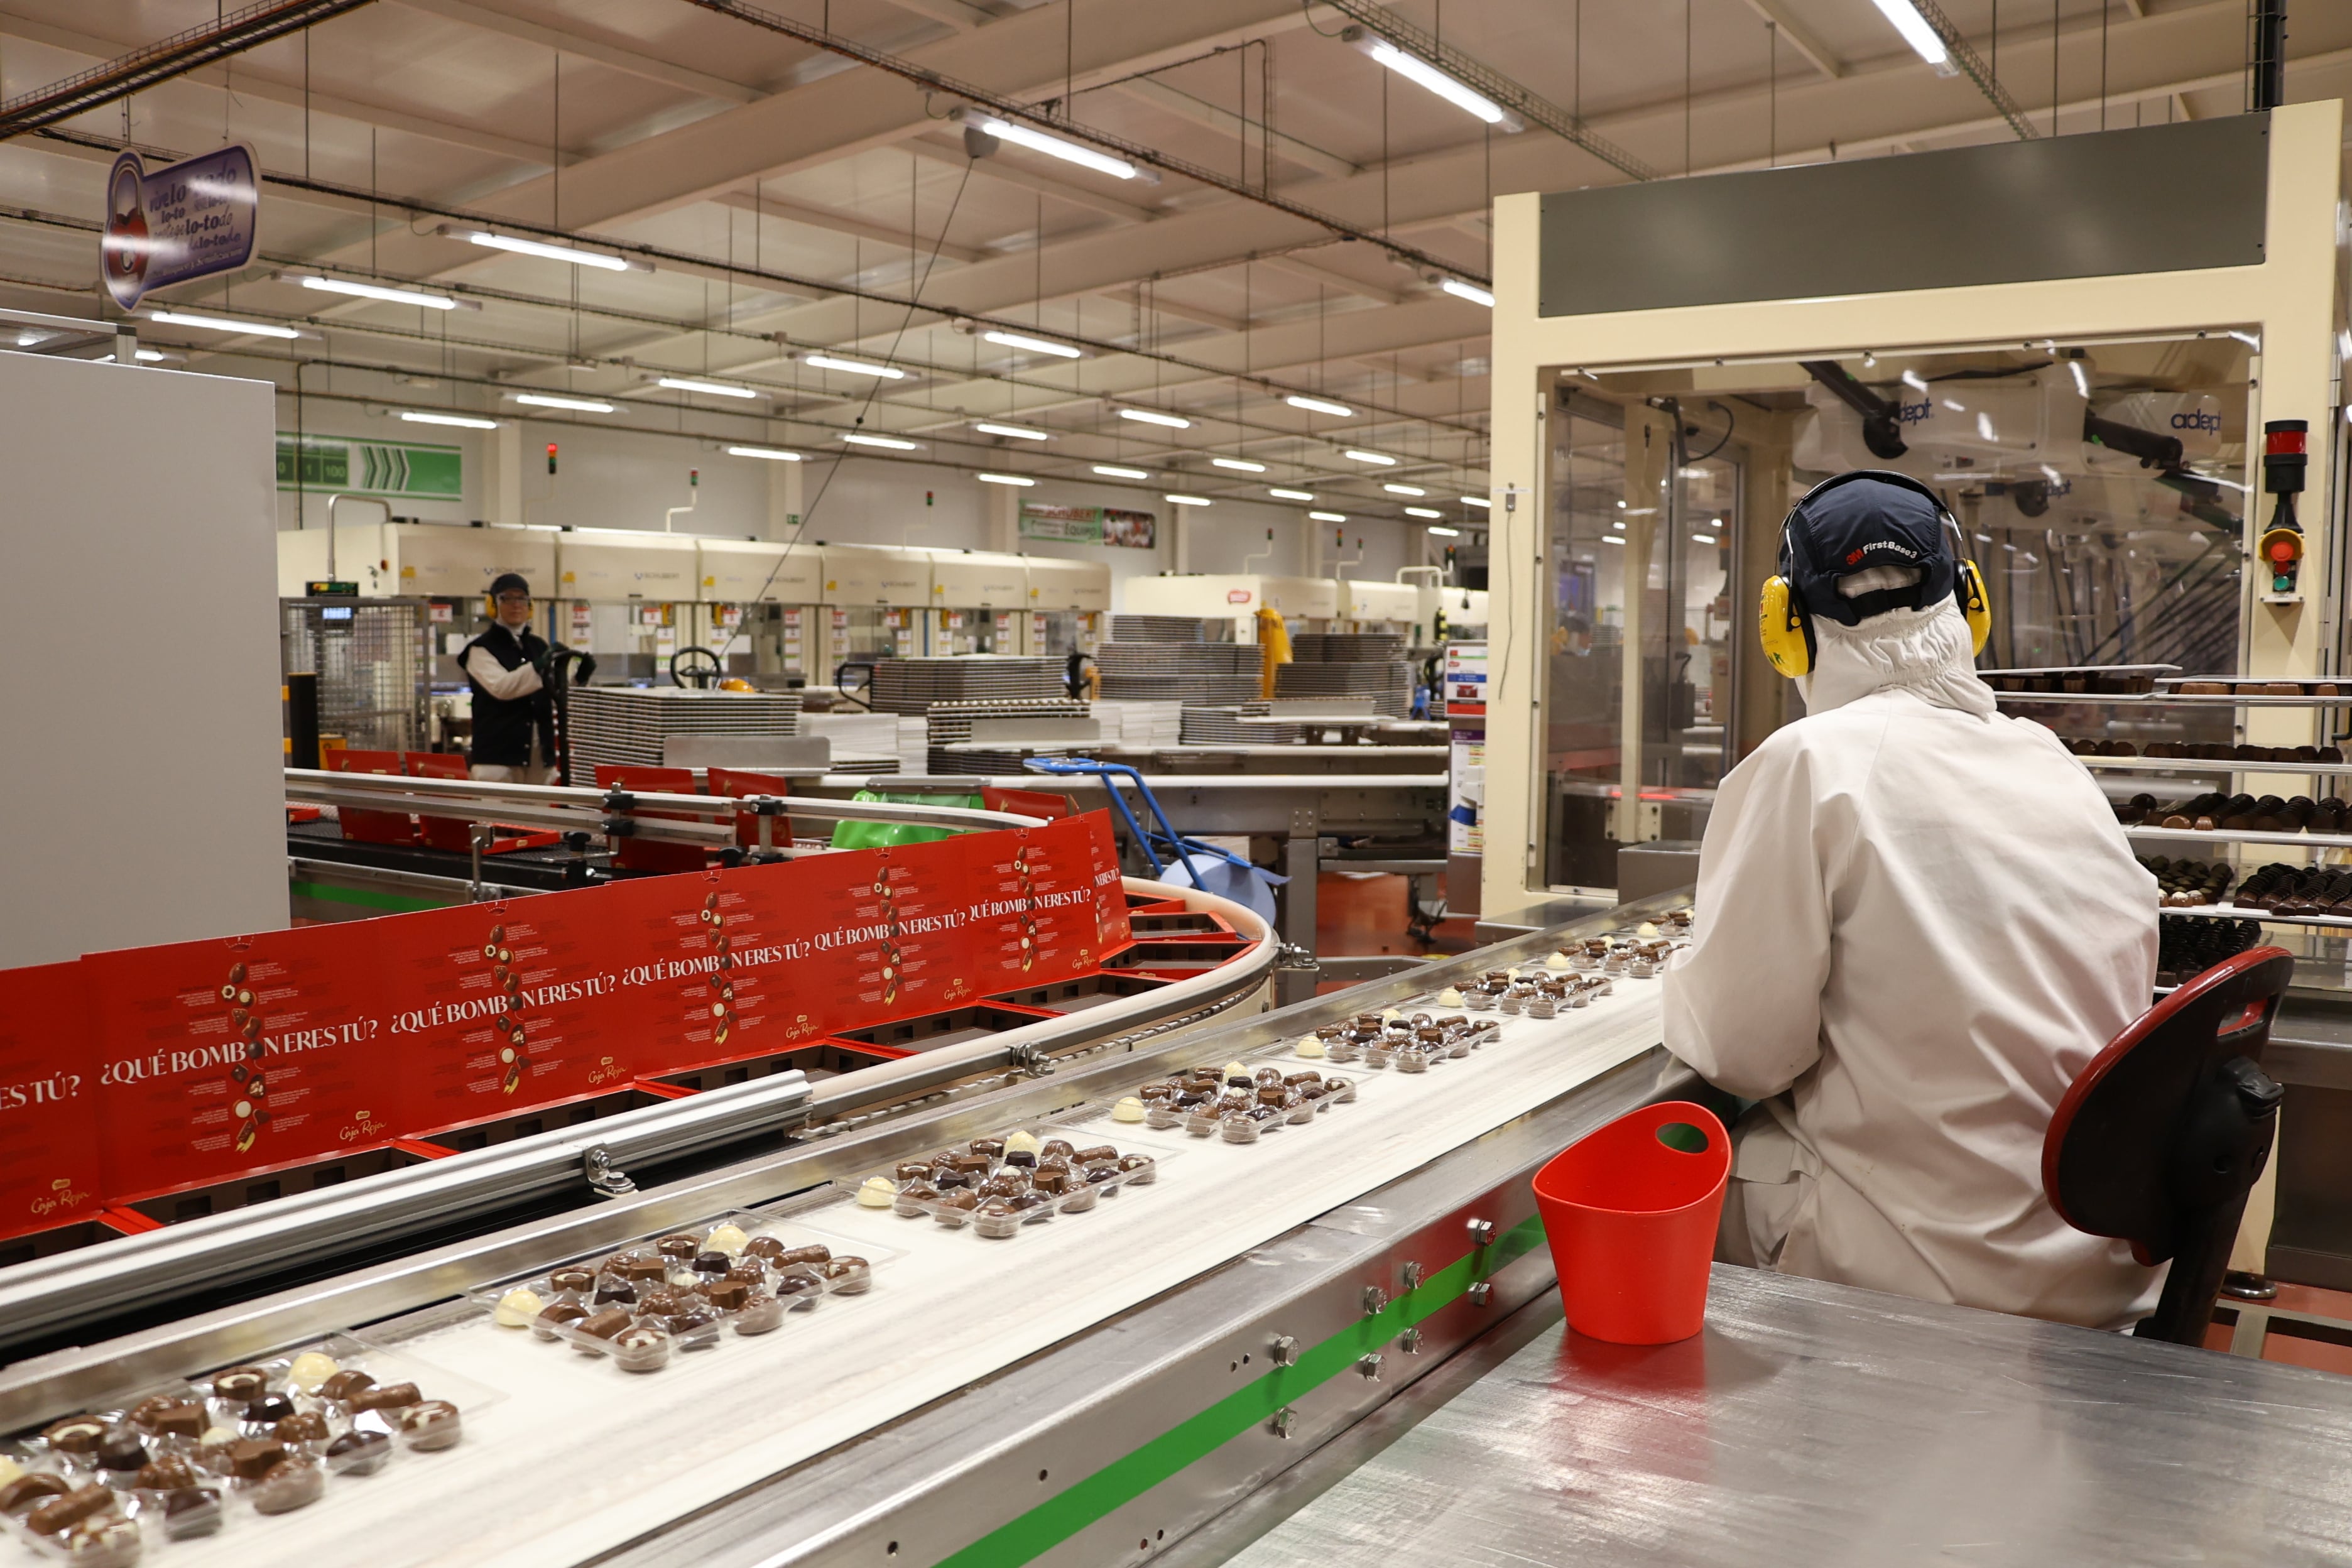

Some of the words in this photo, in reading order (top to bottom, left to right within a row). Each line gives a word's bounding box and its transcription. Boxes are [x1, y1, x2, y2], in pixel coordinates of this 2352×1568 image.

[1899, 397, 1932, 426] dept
[1044, 891, 1070, 908] ERES
[1071, 886, 1092, 902] TÚ?
[910, 915, 942, 934] ERES
[942, 908, 966, 928] TÚ?
[622, 959, 667, 986] ¿QUÉ
[745, 945, 782, 966] ERES
[783, 938, 810, 961] TÚ?
[390, 1001, 444, 1034] ¿QUÉ
[538, 981, 582, 1006] ERES
[583, 972, 616, 997] TÚ?
[101, 1048, 167, 1086] ¿QUÉ
[284, 1026, 337, 1054] ERES
[339, 1016, 378, 1045] TÚ?
[30, 1071, 81, 1104] TÚ?
